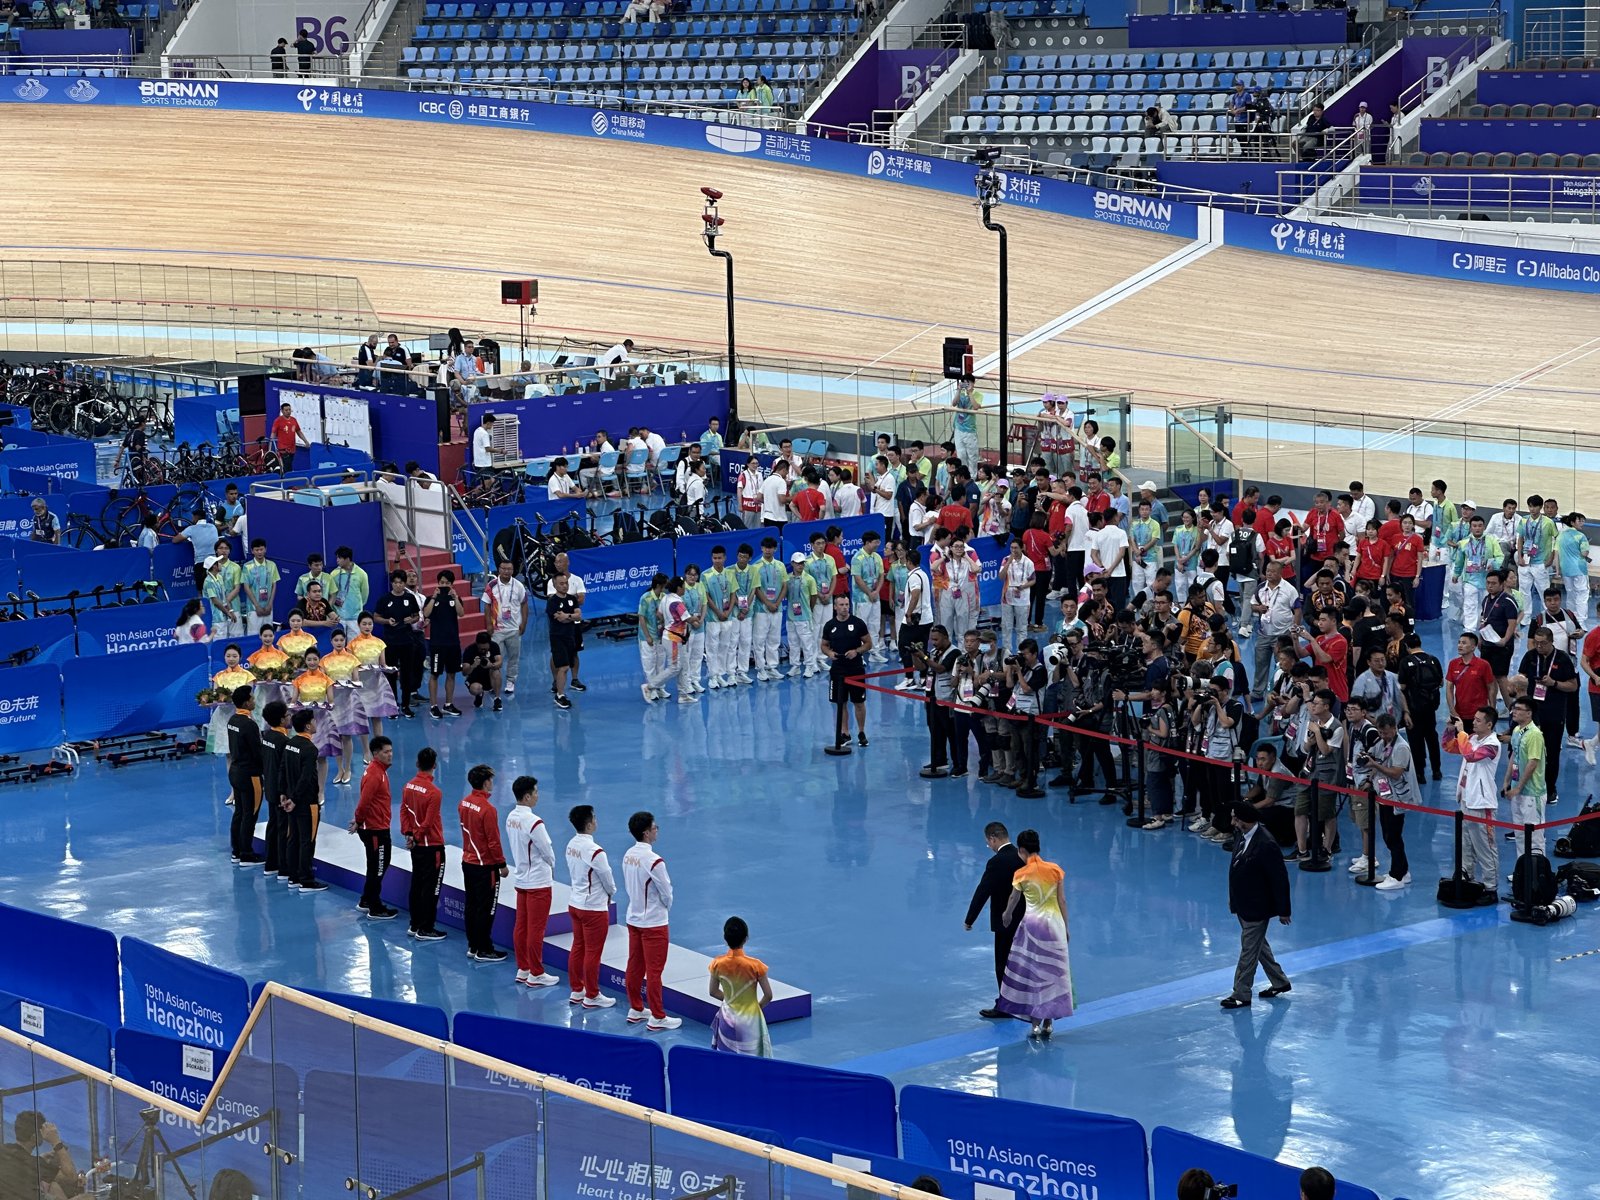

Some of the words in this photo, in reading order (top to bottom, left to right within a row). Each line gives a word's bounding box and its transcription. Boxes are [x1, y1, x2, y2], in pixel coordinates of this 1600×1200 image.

[296, 16, 349, 56] B6
[138, 81, 219, 99] BORNAN
[319, 90, 363, 107] 中国电信
[141, 97, 170, 105] SPORTS
[175, 98, 219, 107] TECHNOLOGY
[419, 102, 446, 115] ICBC
[468, 103, 530, 122] 中国工商银行
[611, 114, 646, 130] 中国移动
[611, 127, 627, 136] China
[627, 129, 645, 138] Mobile
[765, 134, 811, 153] 吉利汽车
[765, 149, 790, 158] GEELY
[790, 153, 811, 162] AUTO
[886, 156, 932, 175] 太平洋保险
[886, 168, 904, 179] CPIC
[1009, 176, 1041, 197] 支付宝
[1009, 193, 1040, 205] ALIPAY
[1093, 191, 1172, 222] BORNAN
[1094, 210, 1121, 223] SPORTS
[1123, 215, 1170, 231] TECHNOLOGY
[1294, 225, 1346, 251] 中国电信
[1294, 246, 1313, 256] CHINA
[1315, 250, 1345, 260] TELECOM
[1473, 255, 1507, 274] 阿里云
[1539, 263, 1580, 281] Alibaba
[55, 462, 78, 470] Games
[105, 630, 127, 643] 19th
[128, 629, 154, 641] Asian
[155, 627, 176, 637] Gam
[0, 714, 37, 725] @Future
[144, 983, 164, 1003] 19th
[165, 991, 191, 1012] Asian
[191, 1001, 223, 1024] Games
[146, 998, 224, 1048] Hangzhou
[150, 1080, 178, 1100] 19th
[180, 1086, 207, 1106] Asia
[216, 1096, 259, 1118] Games
[947, 1138, 984, 1159] 19th
[987, 1145, 1033, 1167] Asian
[1037, 1153, 1097, 1178] Games
[576, 1182, 614, 1200] Heart
